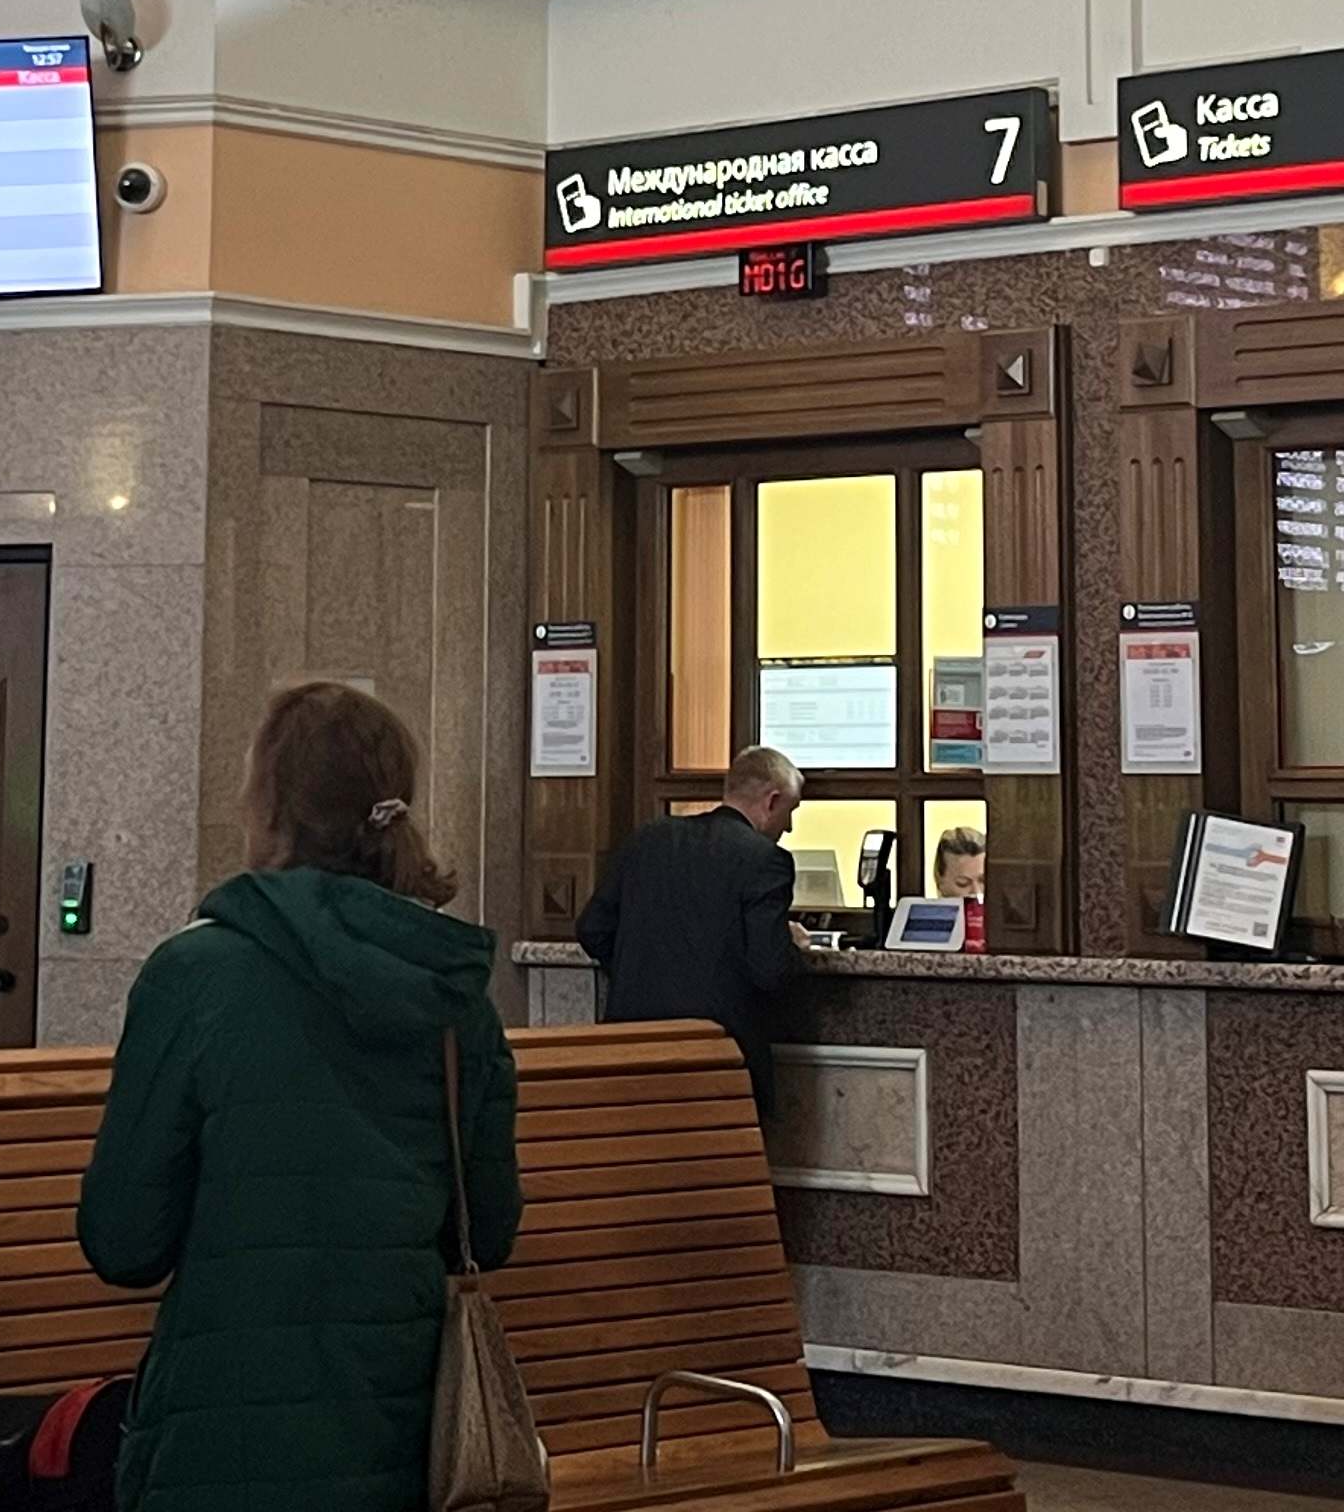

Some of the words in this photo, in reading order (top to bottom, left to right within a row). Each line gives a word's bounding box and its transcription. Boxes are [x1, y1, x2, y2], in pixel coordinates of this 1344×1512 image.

[1195, 91, 1280, 126] Касса
[608, 146, 806, 197] Международная
[809, 140, 879, 171] касса
[983, 116, 1022, 186] 7
[1197, 131, 1272, 162] Tickets
[607, 192, 723, 230] International
[723, 188, 774, 216] ticket
[775, 183, 830, 210] office
